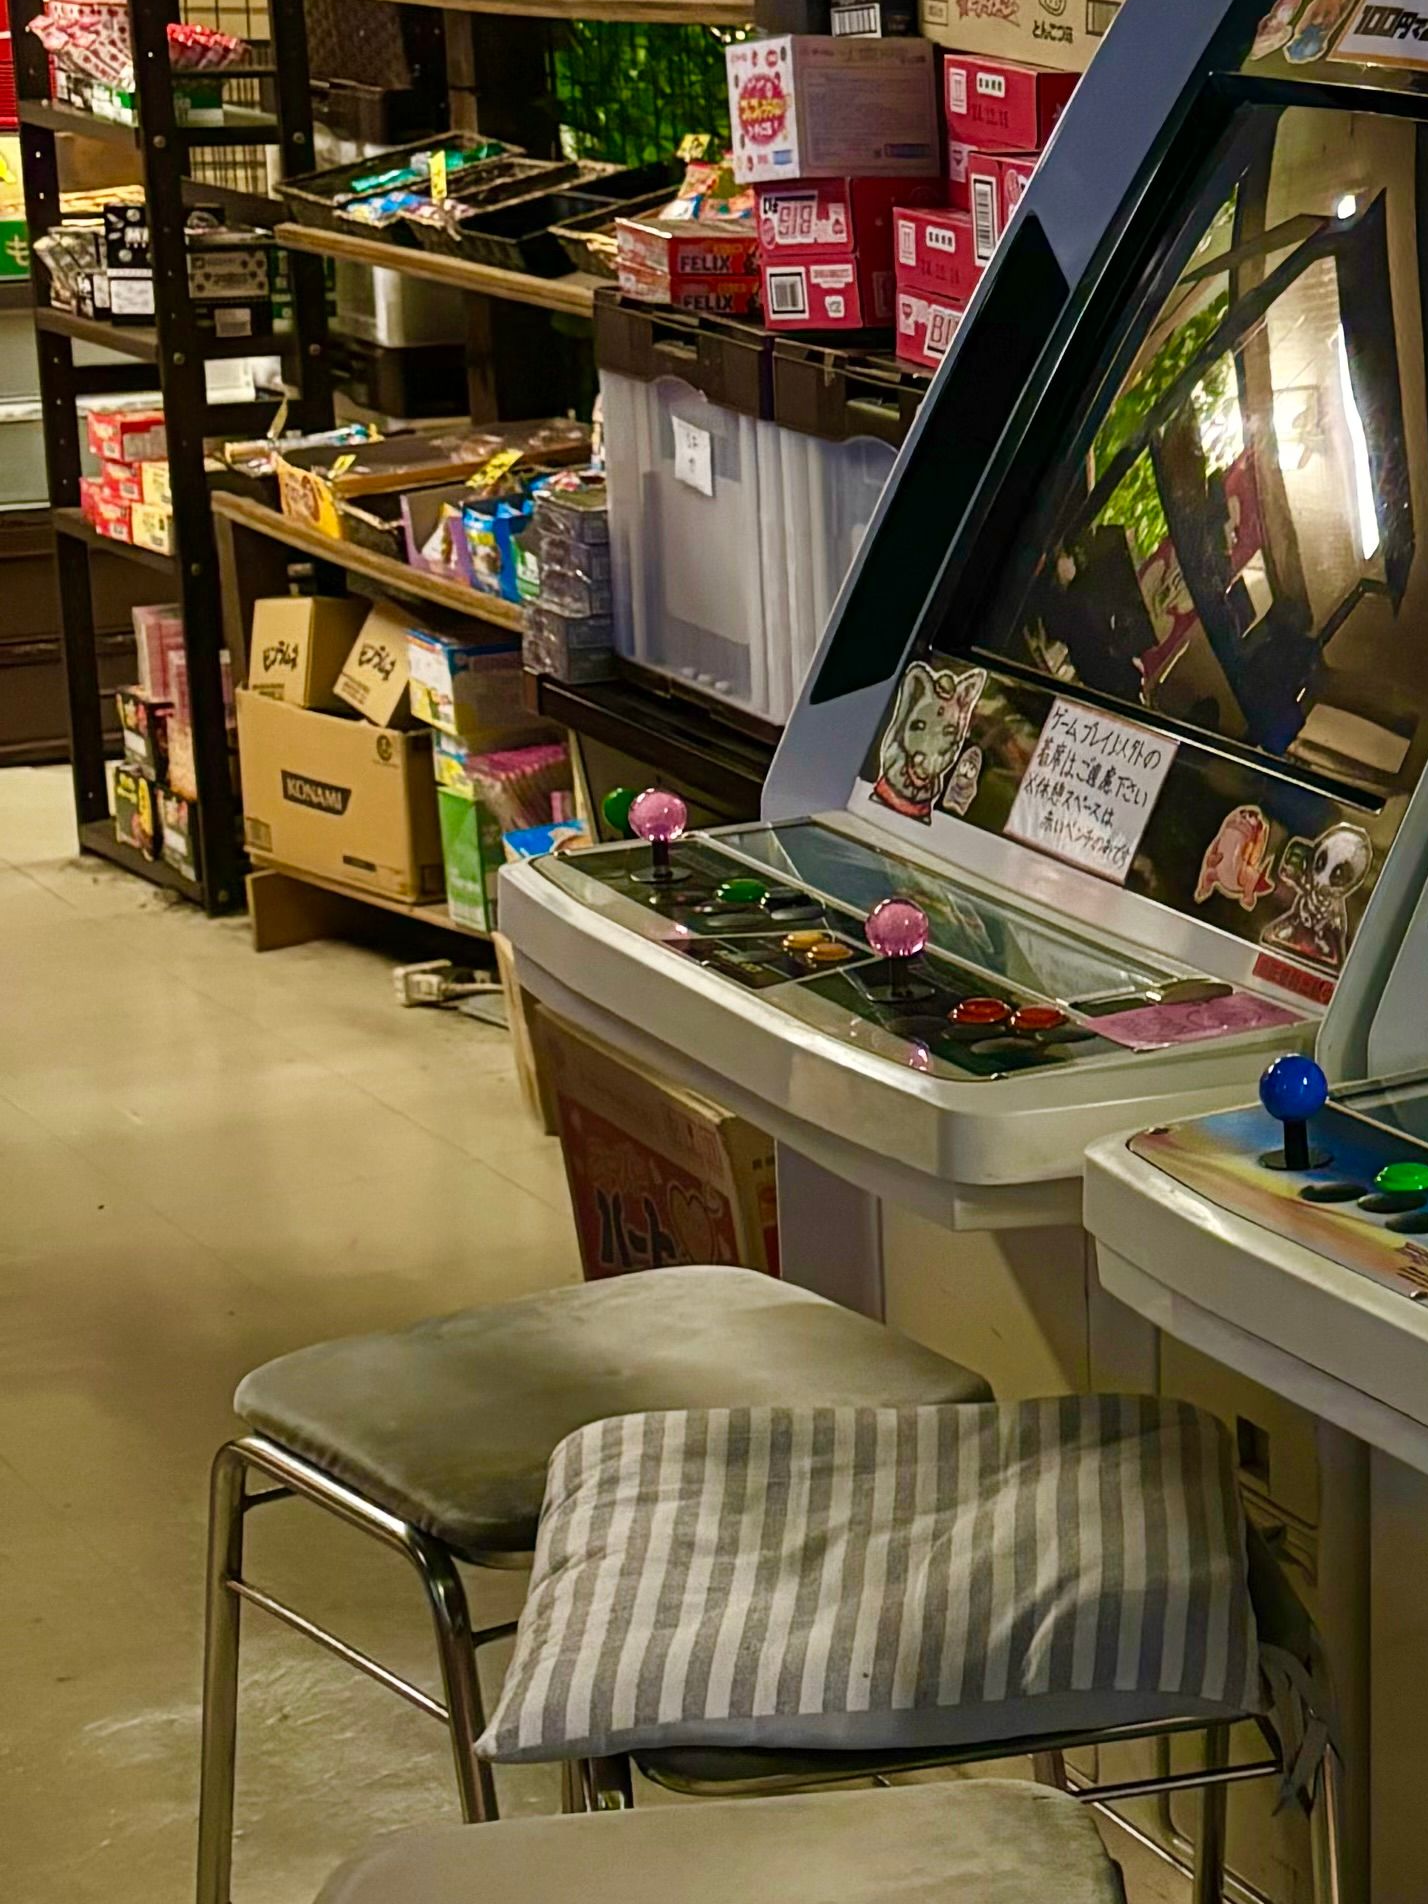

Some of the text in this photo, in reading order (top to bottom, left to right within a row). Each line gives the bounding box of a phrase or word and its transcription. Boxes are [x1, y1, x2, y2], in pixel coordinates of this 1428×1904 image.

[680, 254, 732, 274] FELIX
[682, 295, 734, 313] FELIX
[287, 776, 343, 810] KONAMI
